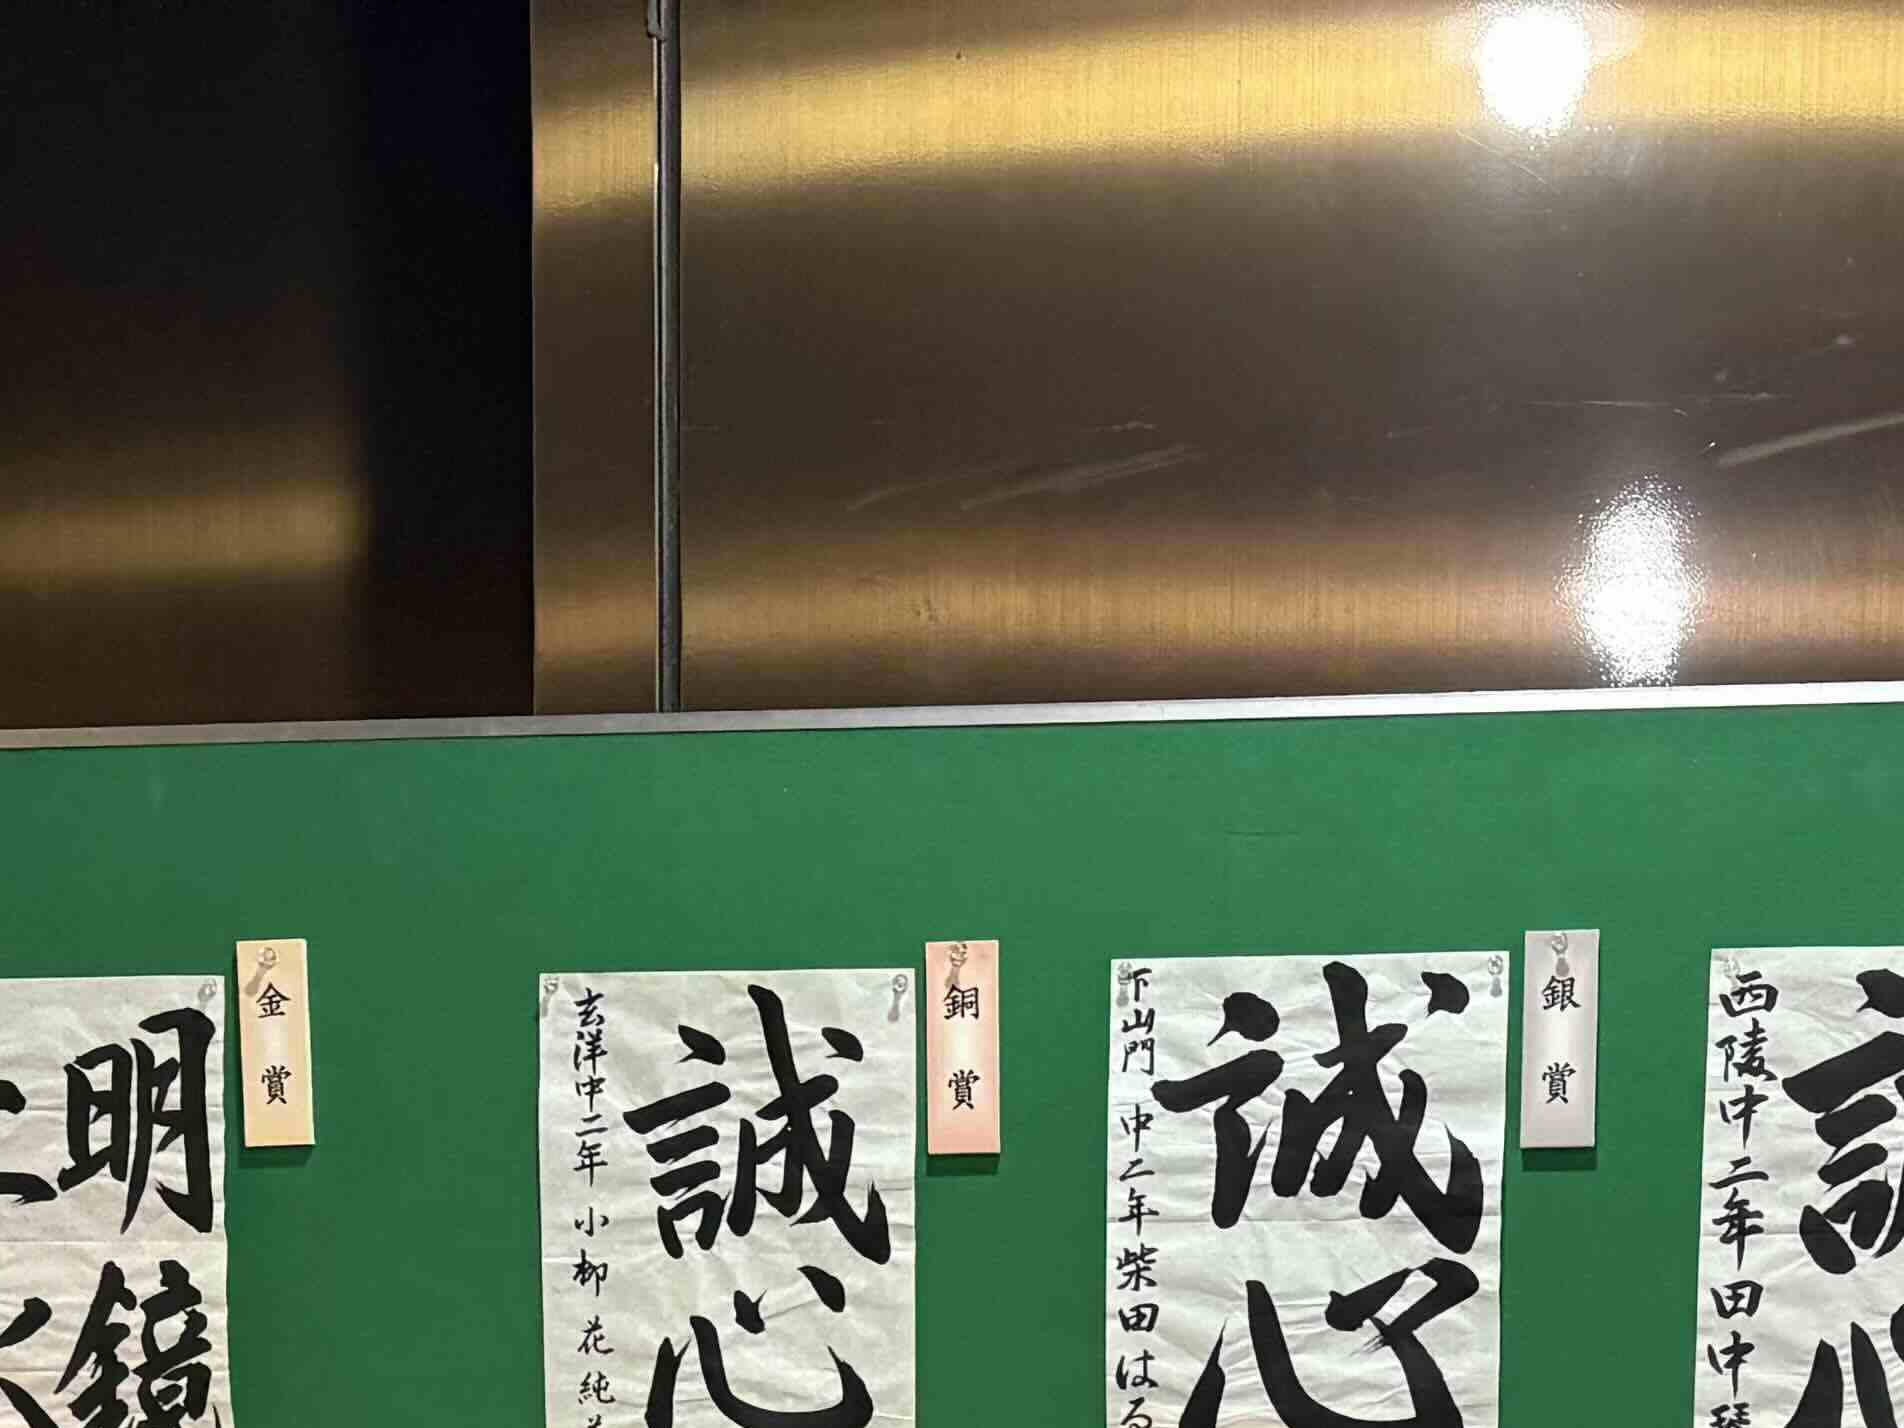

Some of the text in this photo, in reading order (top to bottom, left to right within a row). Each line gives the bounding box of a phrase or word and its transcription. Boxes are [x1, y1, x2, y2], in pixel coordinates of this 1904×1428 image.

[256, 982, 291, 1105] 金賞
[944, 986, 980, 1111] 銅賞
[1542, 975, 1580, 1105] 銀賞
